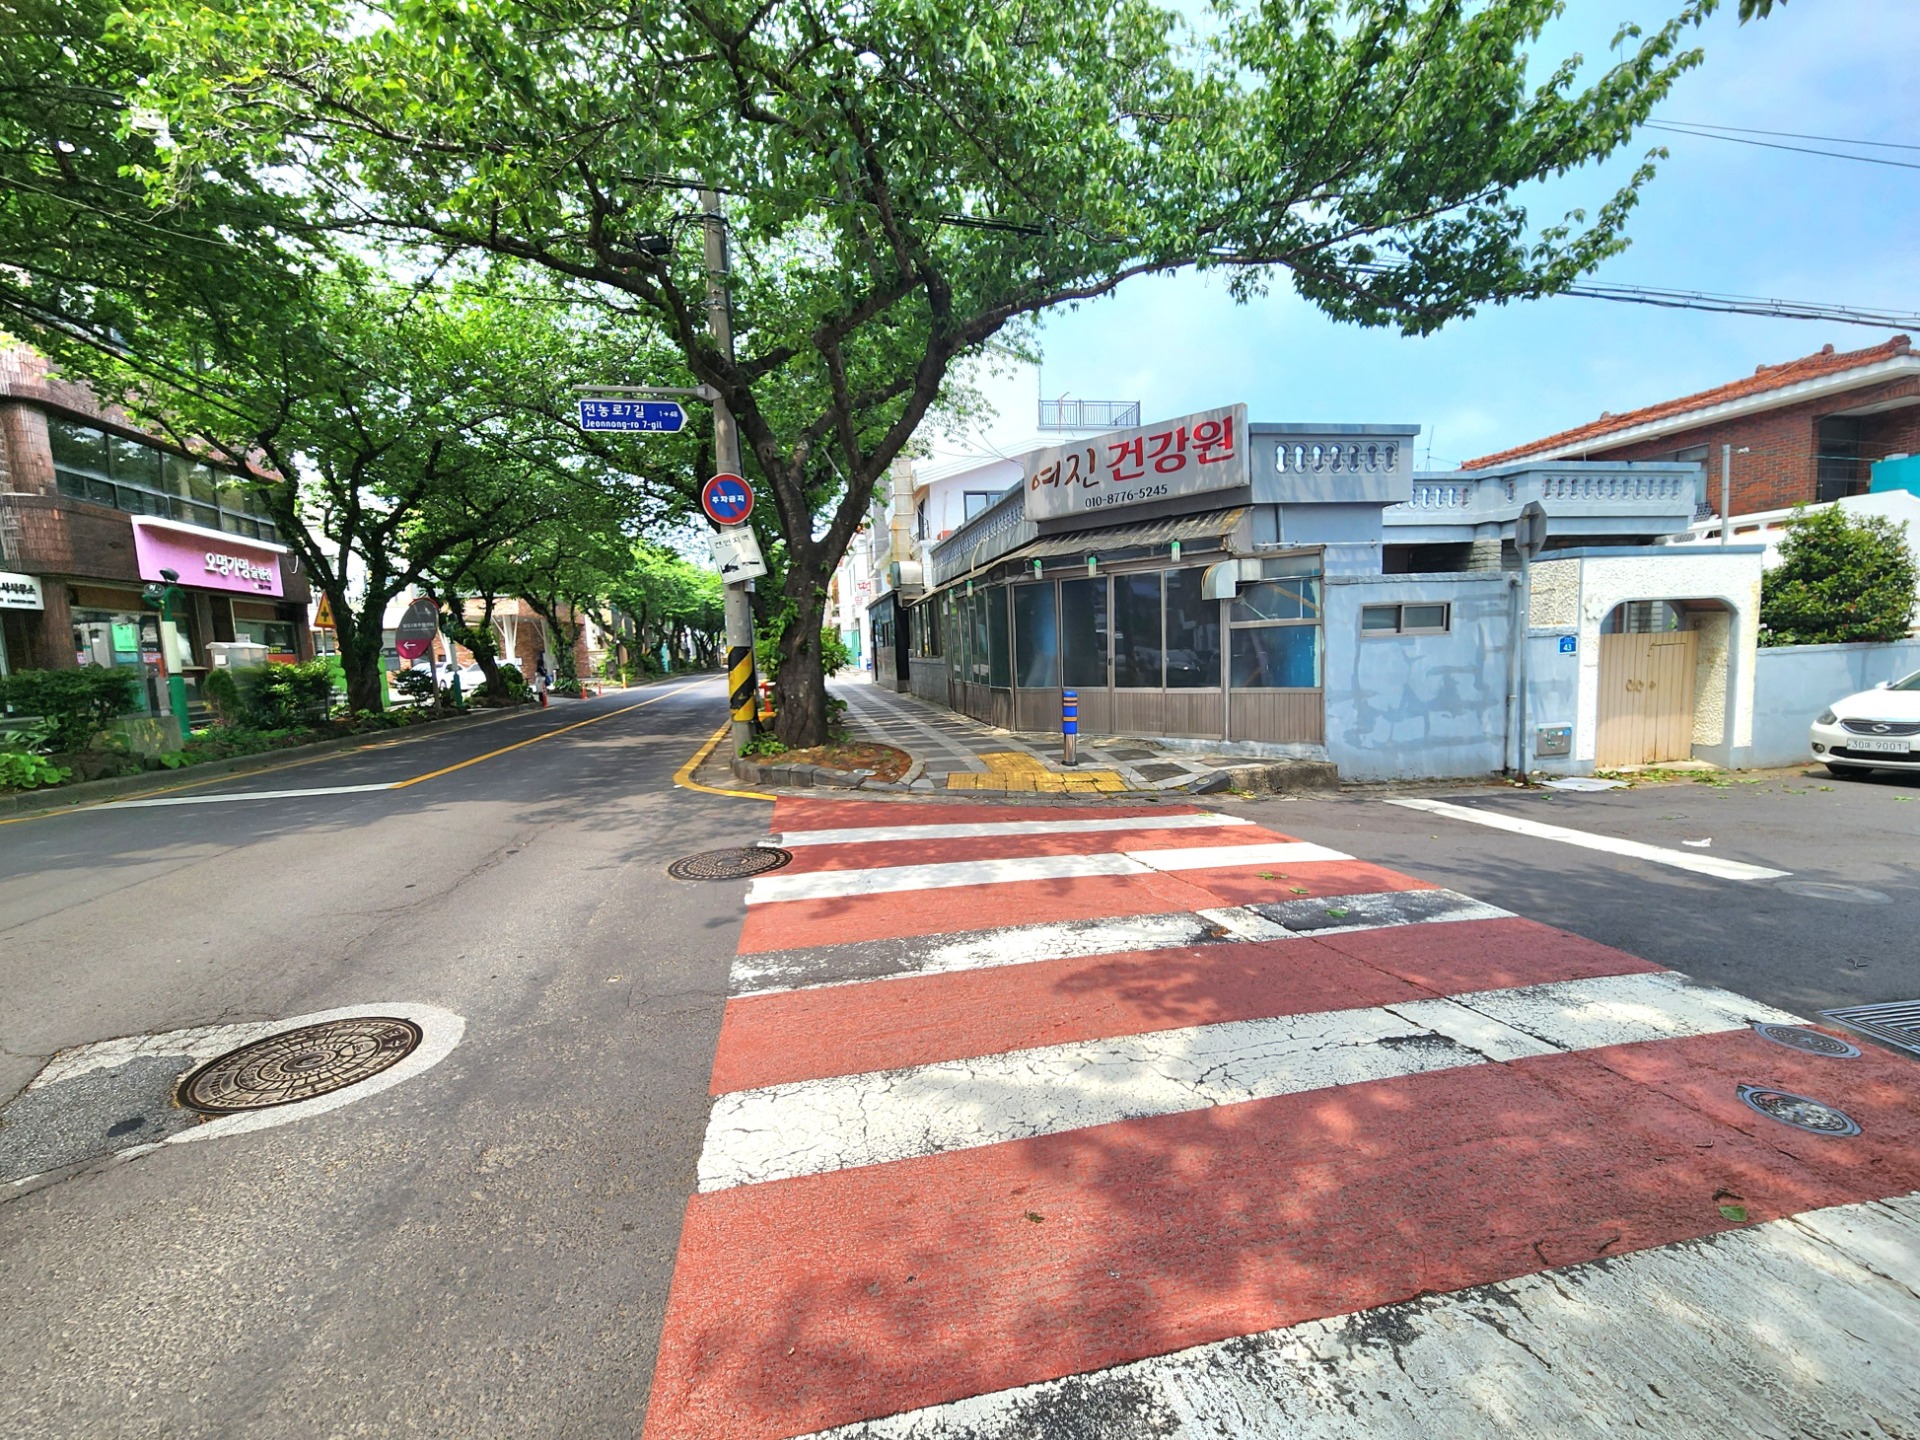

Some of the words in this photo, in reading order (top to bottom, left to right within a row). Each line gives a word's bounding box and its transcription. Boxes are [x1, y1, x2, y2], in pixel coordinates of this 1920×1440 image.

[583, 403, 645, 419] 전농로7길
[585, 419, 640, 430] Jeonnong-ro
[642, 420, 663, 430] 7-gil
[1031, 447, 1100, 492] 여진
[1106, 415, 1235, 483] 건강원
[712, 495, 745, 504] 주차금지
[1084, 483, 1169, 509] 010-8776-5245
[204, 552, 250, 579] 오멍가멍
[1563, 643, 1572, 651] 43
[1876, 742, 1902, 751] 9001
